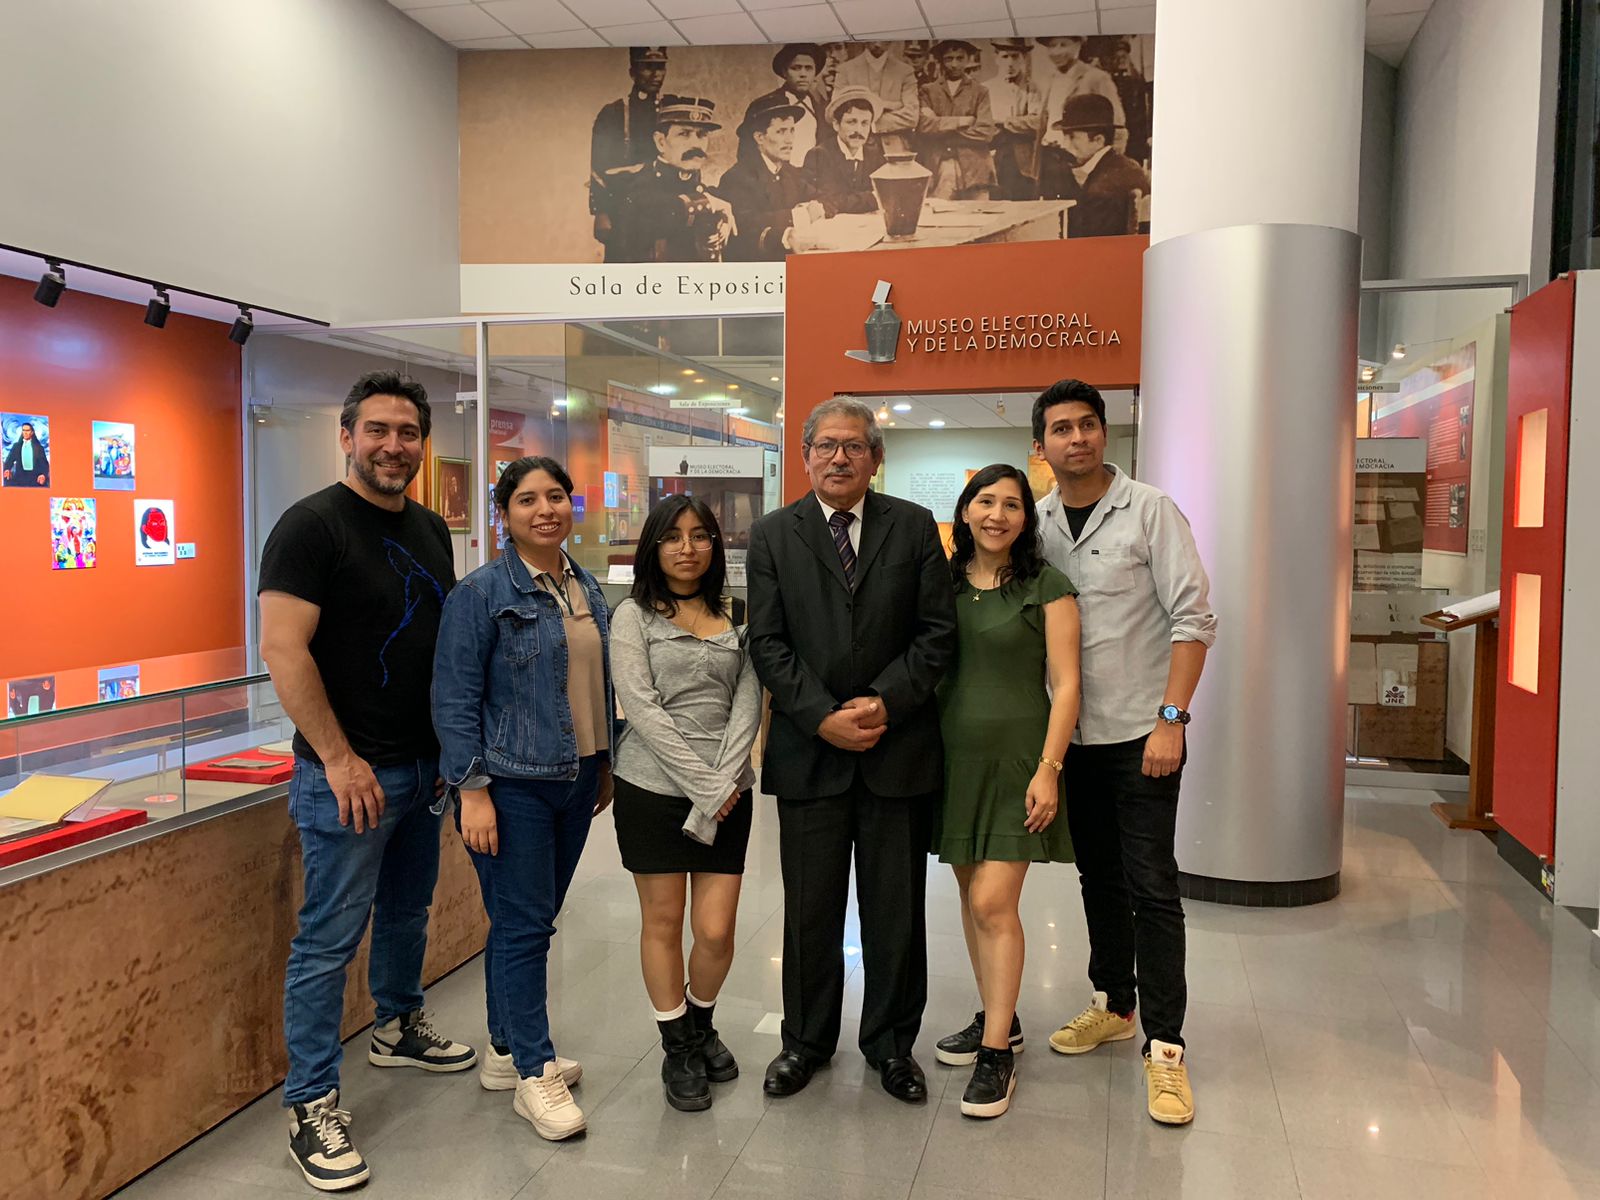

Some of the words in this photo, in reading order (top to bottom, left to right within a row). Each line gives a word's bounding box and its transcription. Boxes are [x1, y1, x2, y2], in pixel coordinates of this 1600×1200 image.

[570, 275, 622, 296] Sala
[636, 275, 662, 295] de
[677, 275, 783, 301] Exposici
[907, 317, 974, 335] MUSEO
[981, 312, 1092, 332] ELECTORAL
[907, 338, 918, 353] Y
[925, 337, 947, 352] DE
[954, 335, 978, 351] LA
[984, 329, 1121, 350] DEMOCRACIA
